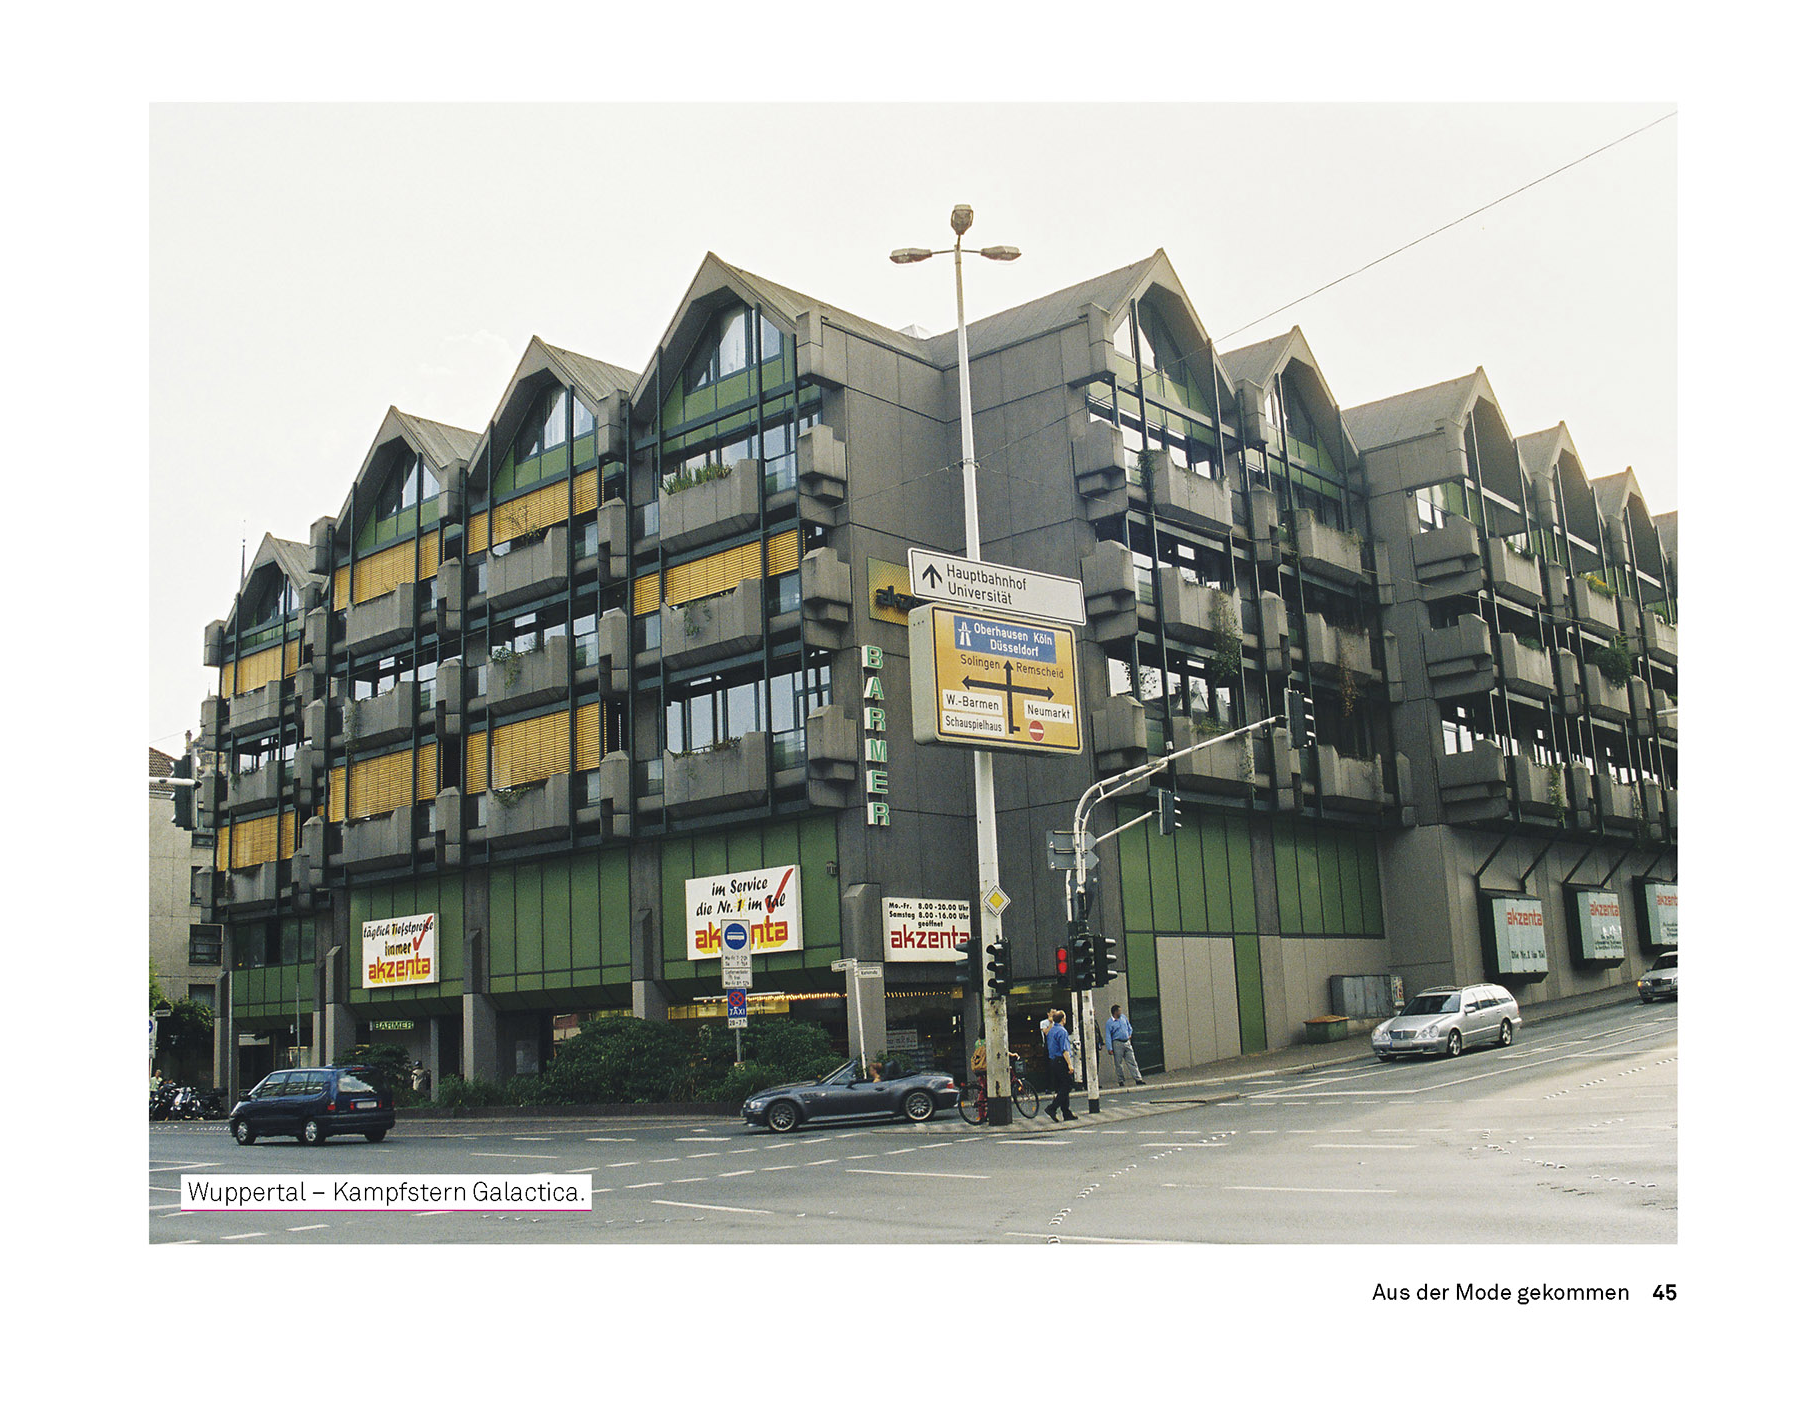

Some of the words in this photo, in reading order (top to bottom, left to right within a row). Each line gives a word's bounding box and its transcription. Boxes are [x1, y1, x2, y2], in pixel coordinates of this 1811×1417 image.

[946, 563, 1027, 591] Hauptbahnhof
[948, 581, 1012, 605] Universität
[974, 622, 1029, 642] Oberhausen
[1033, 632, 1053, 646] Köln
[990, 639, 1039, 657] Düsseldorf
[960, 654, 1001, 670] Solingen
[1016, 661, 1064, 679] Remscheid
[946, 693, 999, 711] W.-Barmen
[1027, 704, 1070, 719] Neumarkt
[945, 715, 1003, 732] Schauspielhaus
[861, 644, 890, 827] BARMER
[711, 882, 726, 897] im
[730, 876, 768, 895] Service
[696, 902, 713, 917] die
[717, 900, 733, 914] Nr.
[737, 899, 743, 912] 1
[748, 897, 762, 911] im
[766, 893, 786, 909] Tal
[958, 904, 969, 912] Uhr
[1590, 900, 1620, 917] akzenta
[889, 910, 916, 920] Samstag
[958, 912, 969, 920] Uhr
[918, 920, 944, 929] geöffnet
[1507, 907, 1543, 926] akzenta
[363, 924, 389, 941] täglich
[391, 919, 434, 937] Tiefstpreise
[695, 915, 788, 950] aknta
[890, 924, 969, 949] akzenta
[385, 940, 411, 957] immer
[368, 952, 431, 981] akzenta
[729, 1008, 746, 1017] TAXI
[374, 1020, 414, 1030] BARMER
